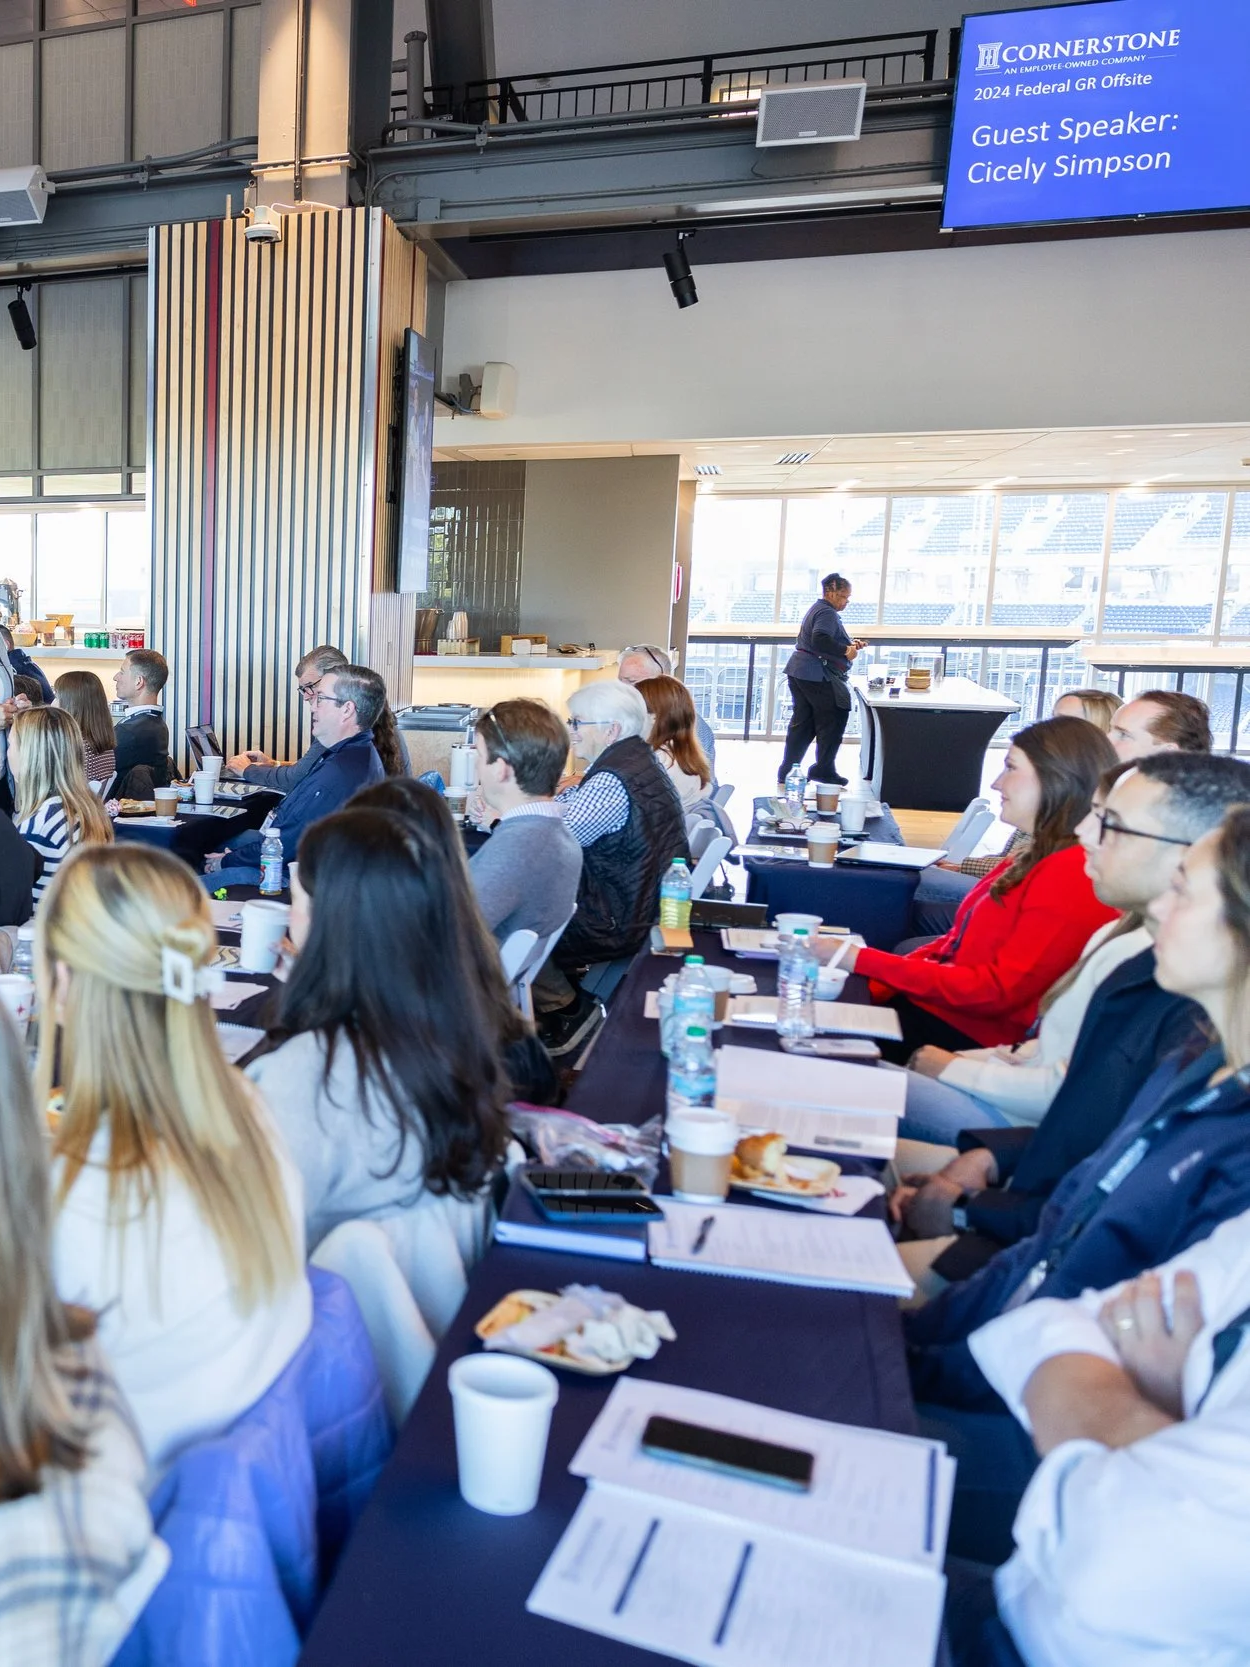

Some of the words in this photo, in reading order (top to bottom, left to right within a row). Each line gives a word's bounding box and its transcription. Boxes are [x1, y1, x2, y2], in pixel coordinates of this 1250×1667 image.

[1002, 29, 1181, 63] CORNERSTONE
[1004, 67, 1017, 75] AN
[1020, 58, 1099, 73] EMPLOYEE-OWNED
[1101, 54, 1146, 66] COMPANY
[974, 87, 1010, 101] 2024
[1015, 79, 1070, 97] Federal
[1075, 77, 1096, 90] GR
[1101, 73, 1152, 89] Offsite
[971, 121, 1051, 147] Guest
[1058, 111, 1179, 144] Speaker:
[967, 157, 1046, 184] Cicely
[1053, 151, 1171, 179] Simpson
